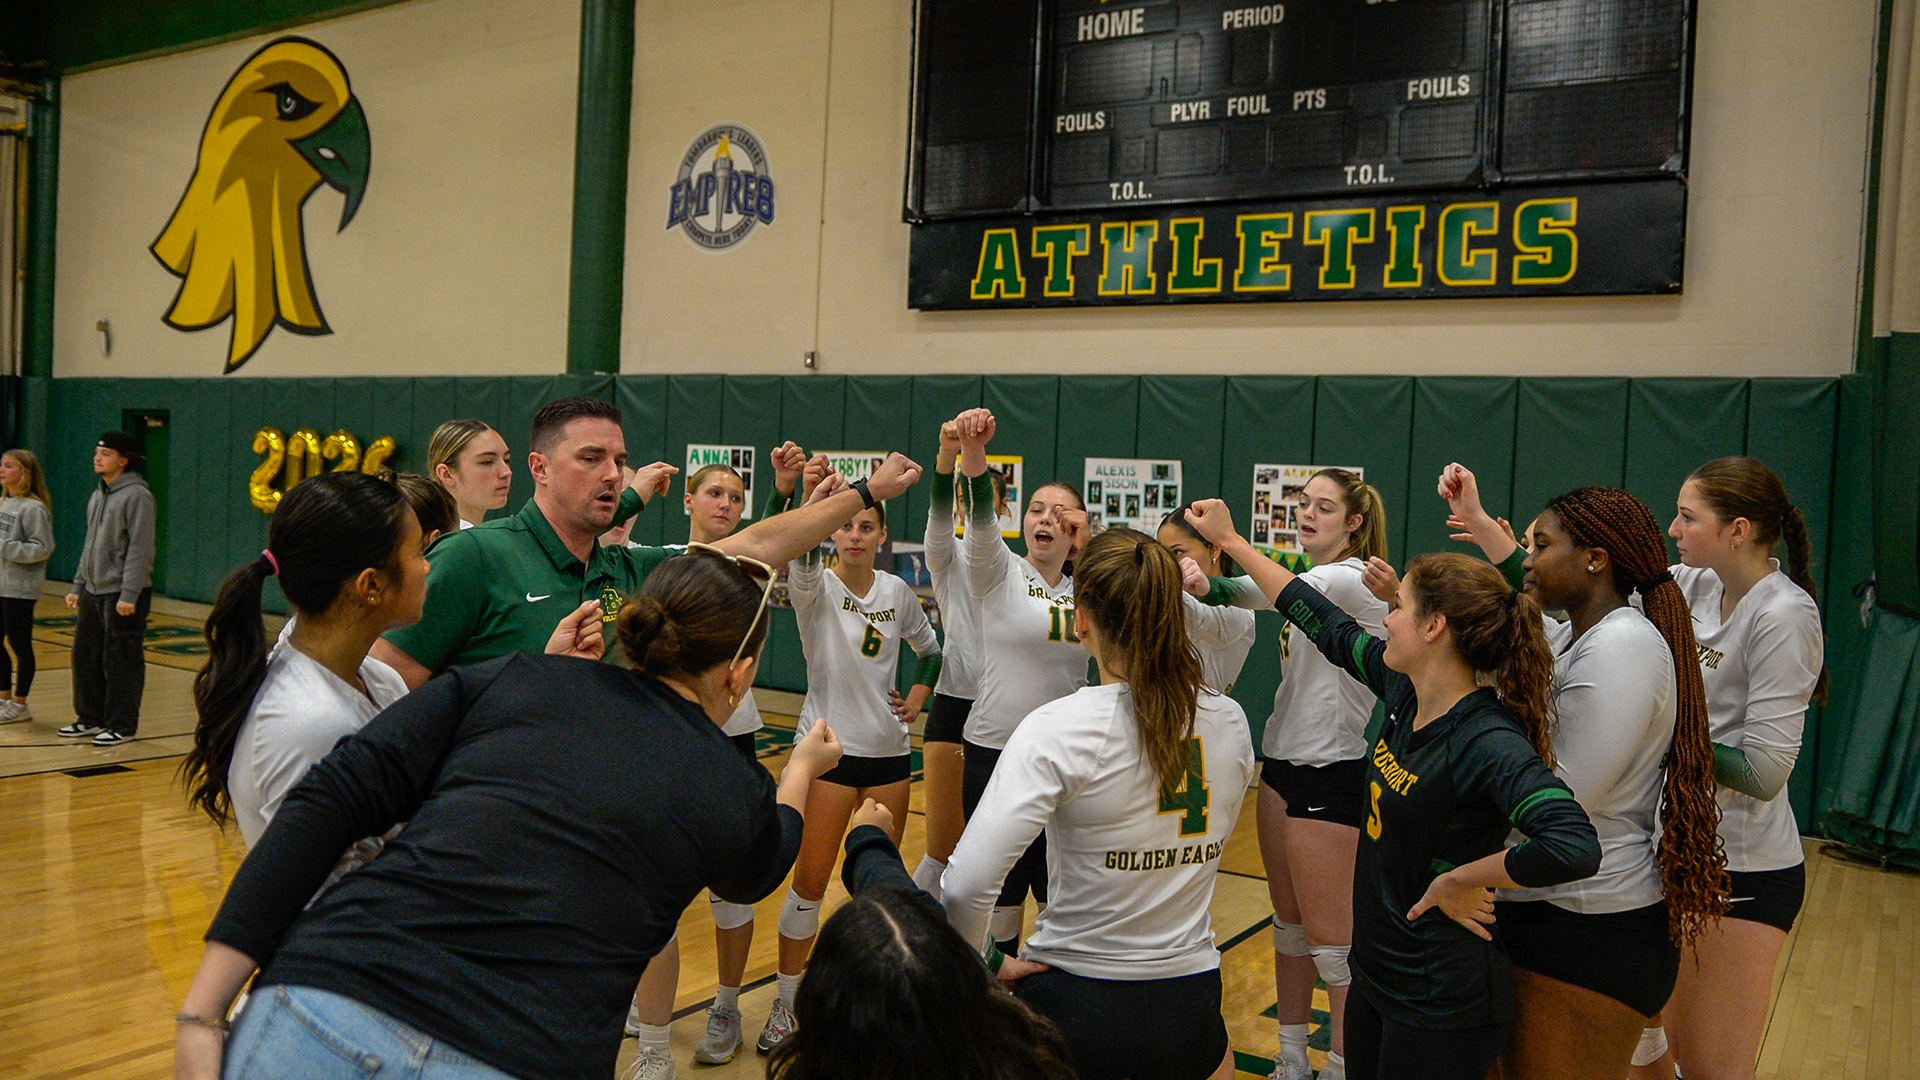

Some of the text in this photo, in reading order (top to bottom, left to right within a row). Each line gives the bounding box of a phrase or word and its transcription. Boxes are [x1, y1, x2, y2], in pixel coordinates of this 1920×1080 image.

[1077, 8, 1145, 42] HOME
[1222, 4, 1285, 31] PERIOD
[1406, 74, 1470, 101] FOULS
[1170, 88, 1327, 123] PLYR FOUL PTS
[1056, 111, 1106, 134] FOULS
[1343, 163, 1395, 186] T.O.L.
[1109, 181, 1153, 201] T.O.L.
[970, 197, 1579, 300] ATHLETICS
[689, 448, 730, 467] ANNA
[1095, 464, 1137, 477] ALEXIS
[1104, 478, 1139, 490] SISON
[861, 622, 885, 659] 6
[1156, 735, 1210, 839] 4
[1104, 848, 1178, 872] GOLDEN
